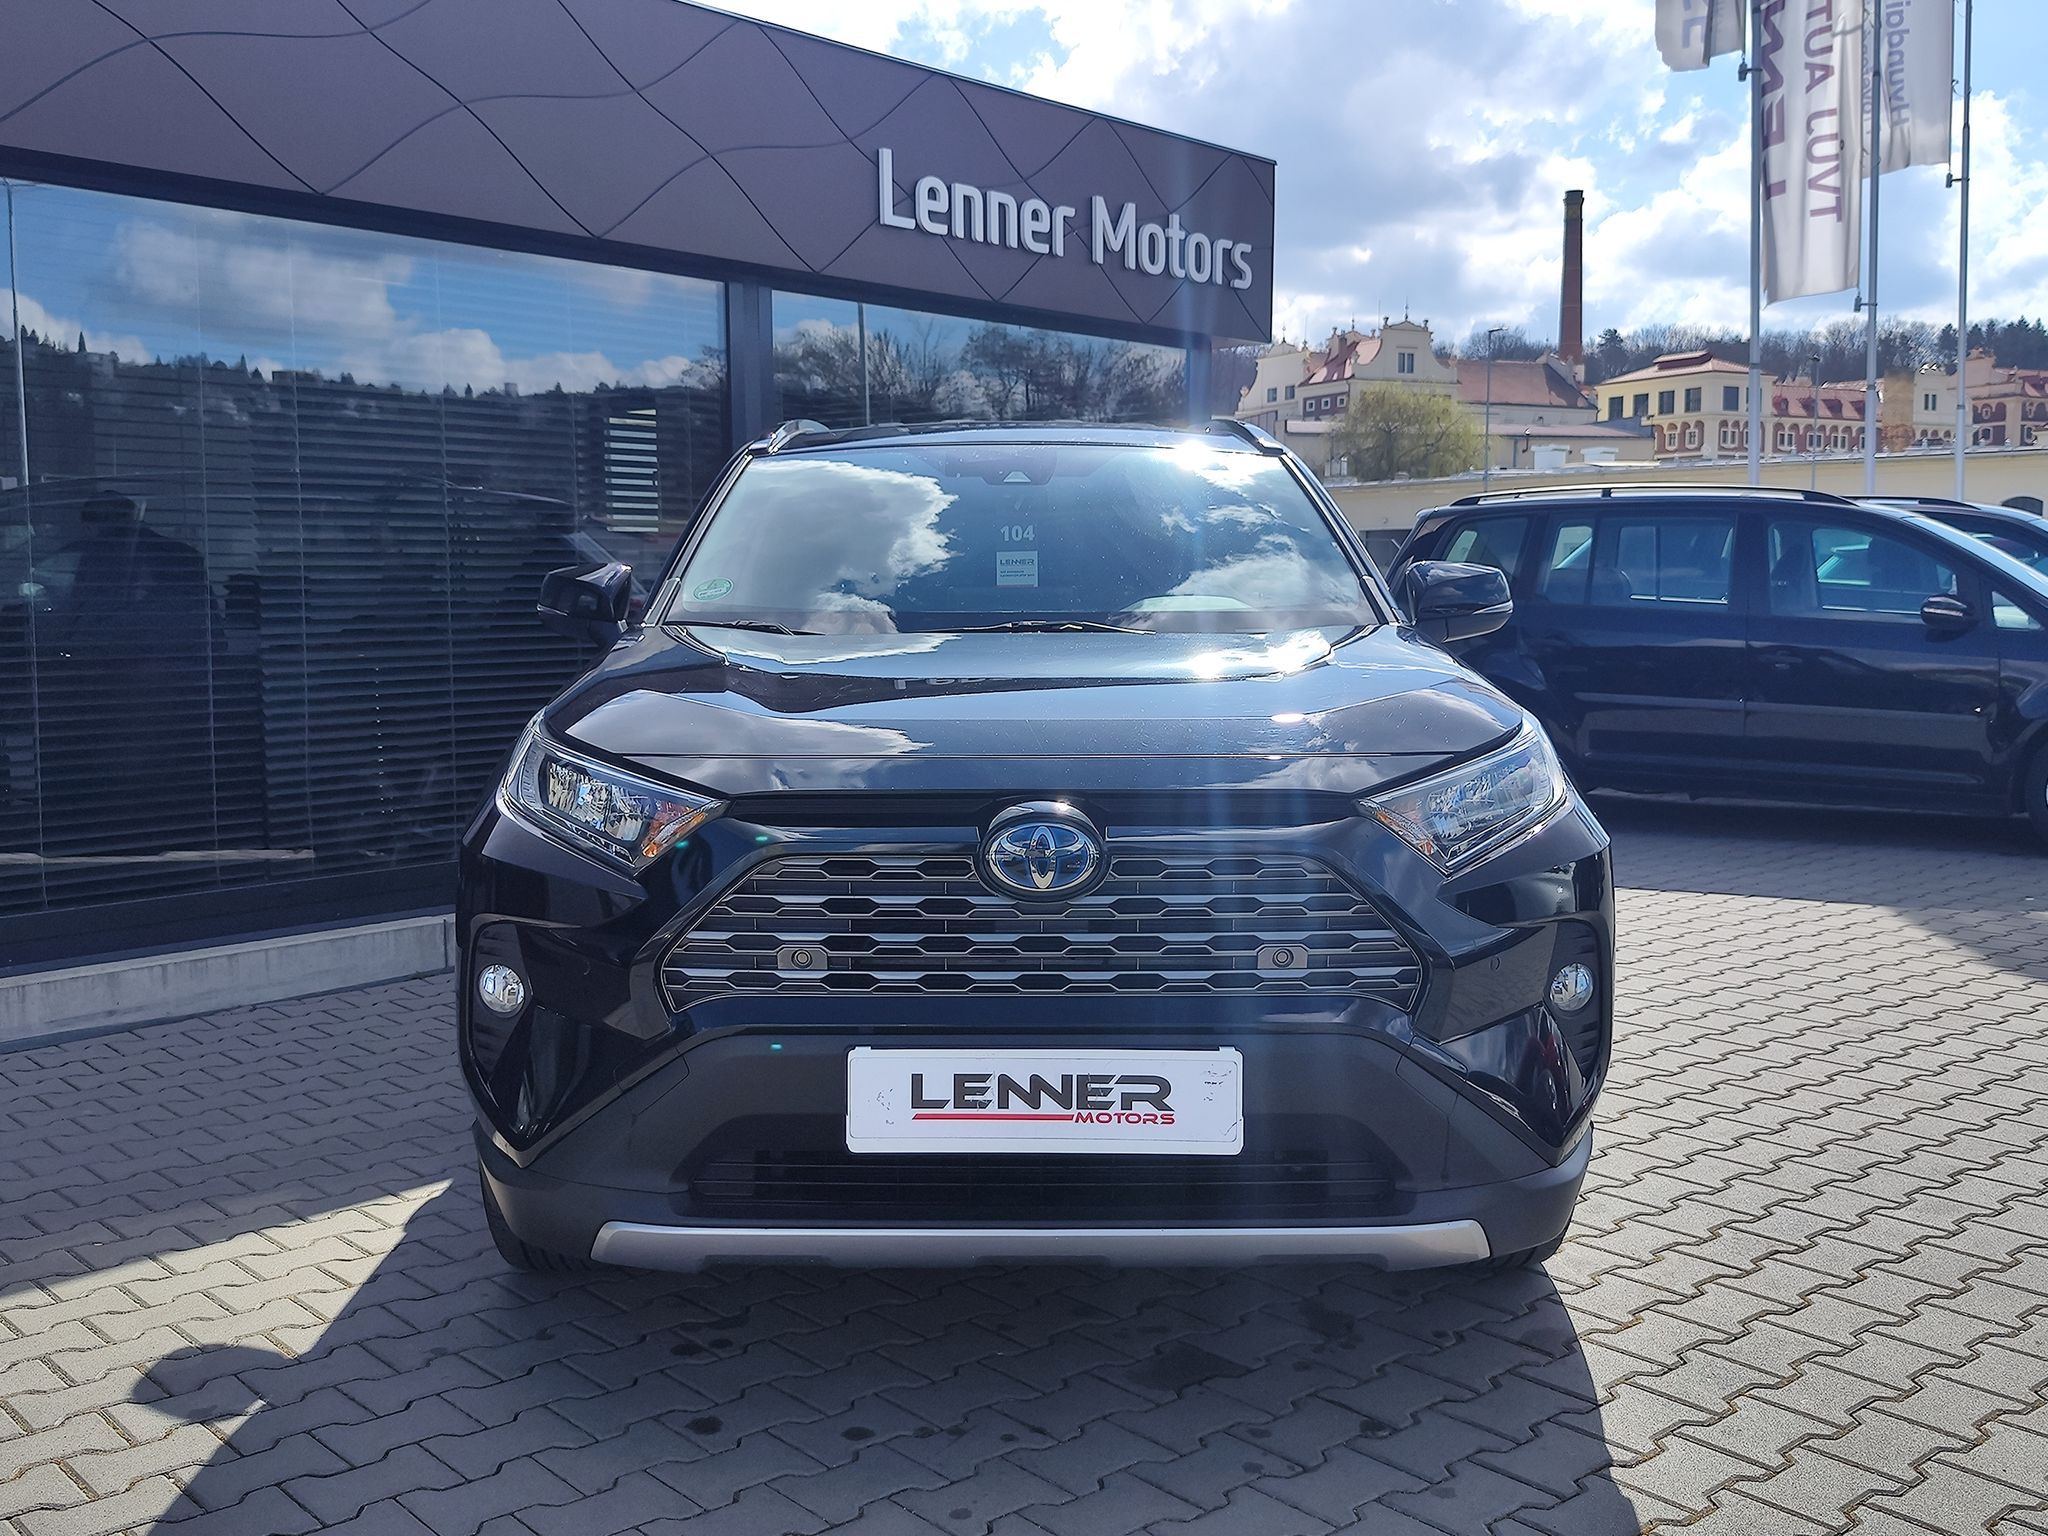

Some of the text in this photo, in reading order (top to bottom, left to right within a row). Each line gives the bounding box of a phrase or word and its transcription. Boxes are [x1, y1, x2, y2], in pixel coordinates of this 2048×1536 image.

[878, 147, 1252, 290] Lenner Motors
[1000, 525, 1035, 541] 104
[911, 1073, 1175, 1111] LENNER
[1074, 1112, 1175, 1125] MOTORS
